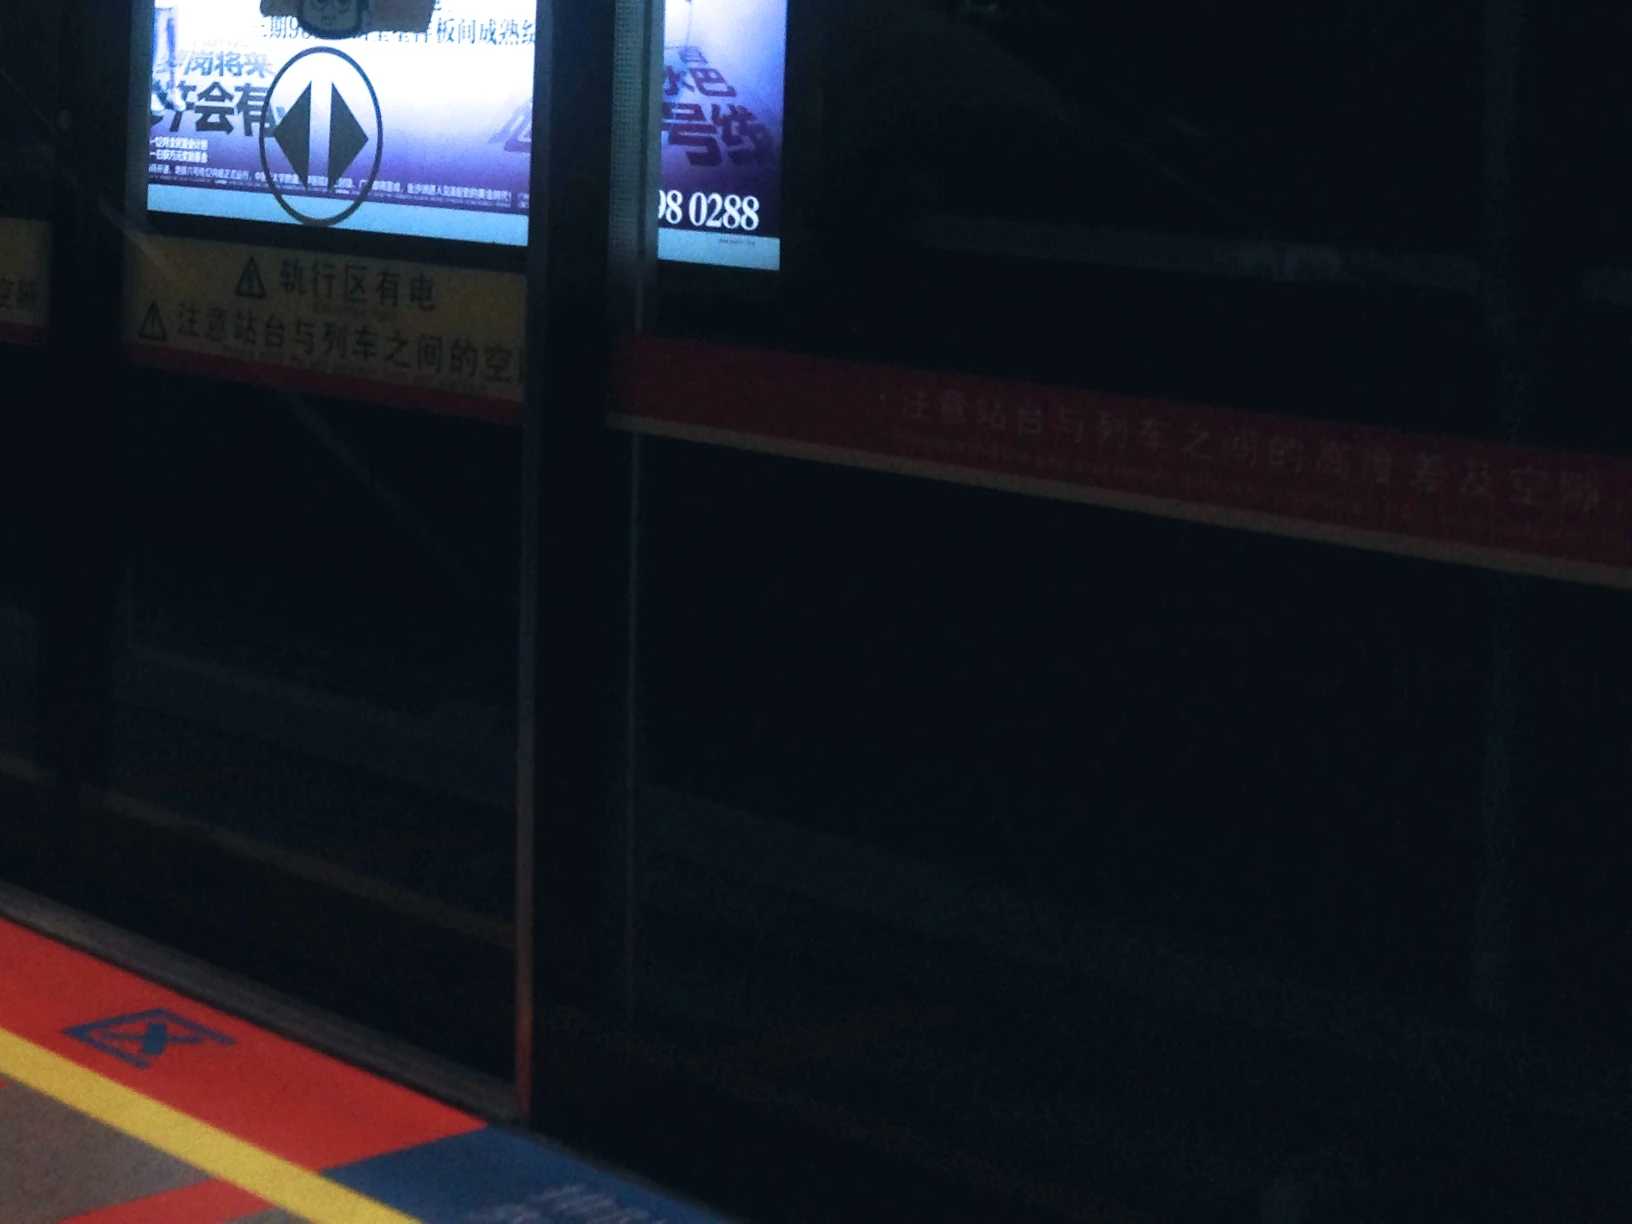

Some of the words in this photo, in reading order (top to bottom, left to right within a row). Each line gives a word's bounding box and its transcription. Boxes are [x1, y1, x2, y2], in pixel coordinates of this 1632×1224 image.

[689, 192, 760, 231] 0288
[280, 258, 436, 311] 轨行区有电
[177, 303, 526, 388] 注意站台与列车之间的空
